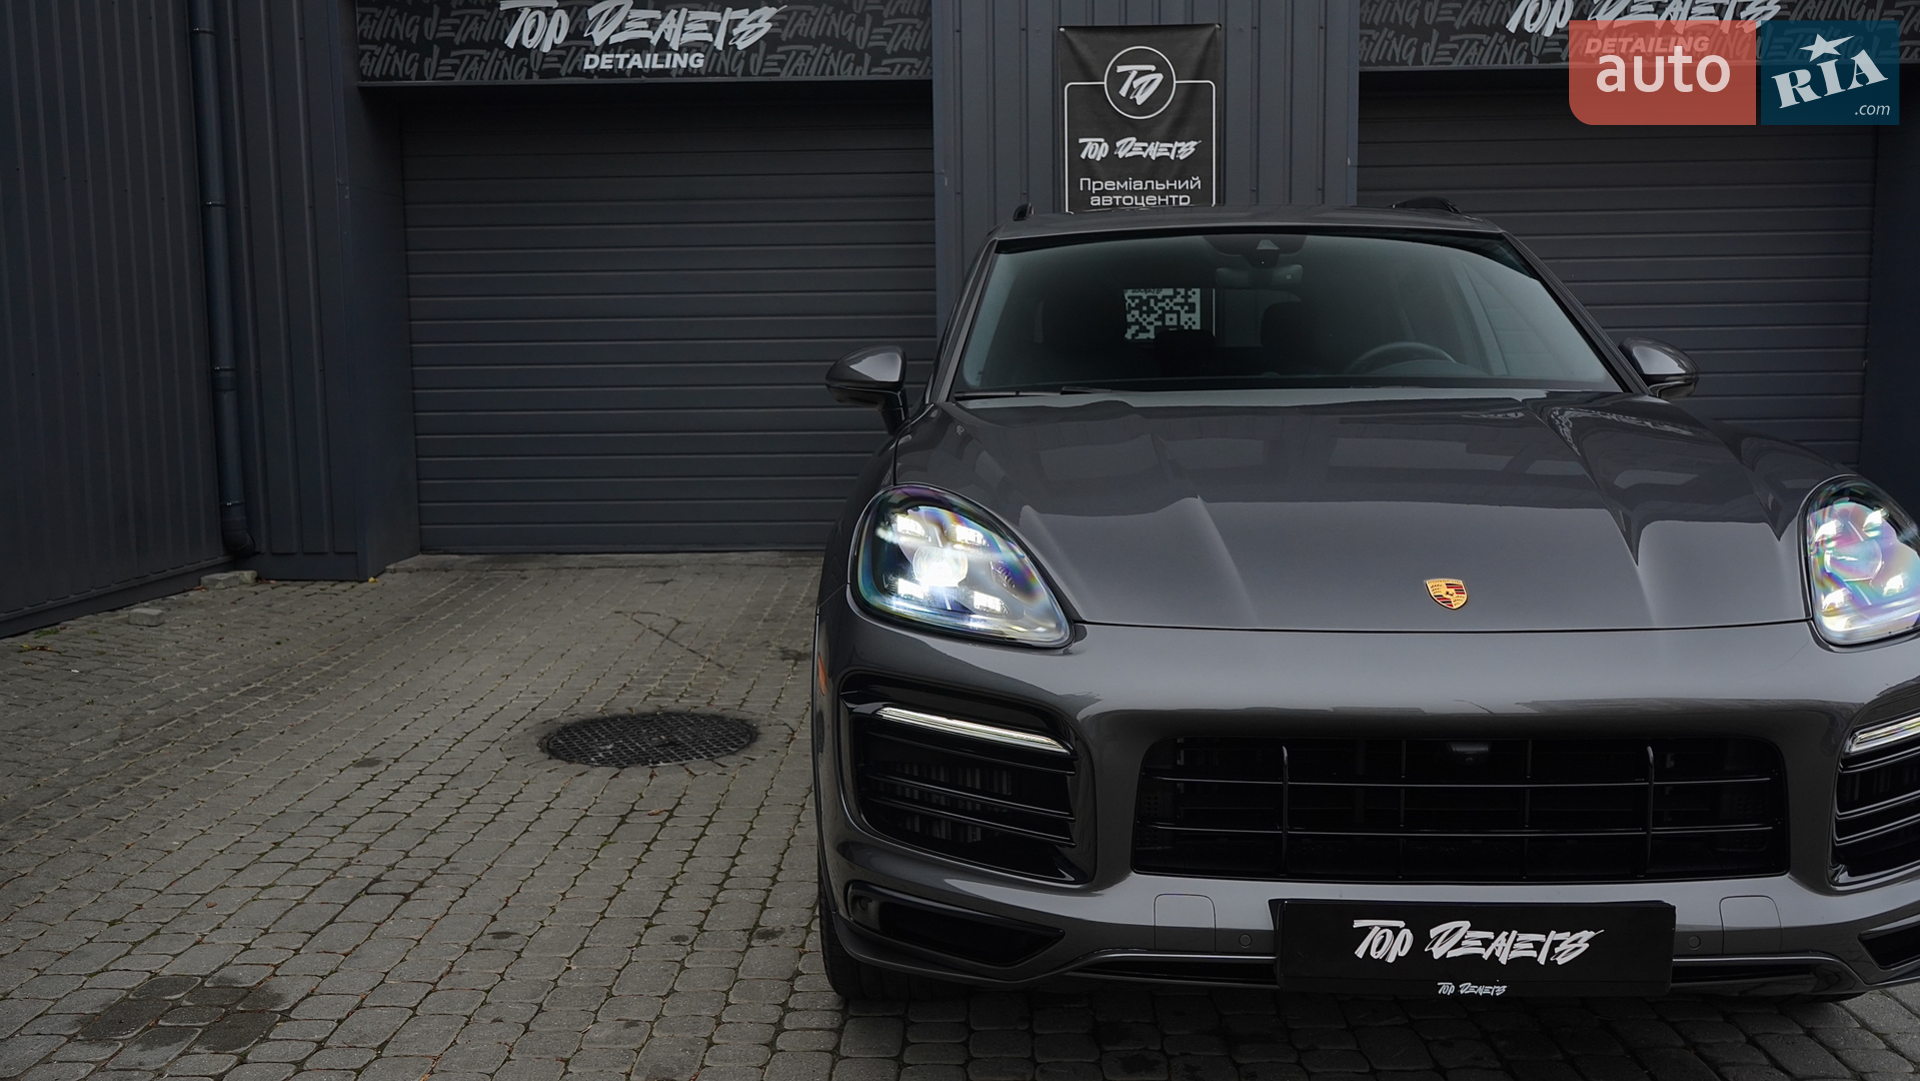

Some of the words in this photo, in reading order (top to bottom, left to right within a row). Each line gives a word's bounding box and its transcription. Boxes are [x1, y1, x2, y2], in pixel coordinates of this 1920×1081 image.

[1585, 36, 1710, 54] DETAILING
[583, 53, 705, 69] DETAILING
[1079, 176, 1201, 194] Преміальний
[1090, 194, 1191, 207] автоцентр
